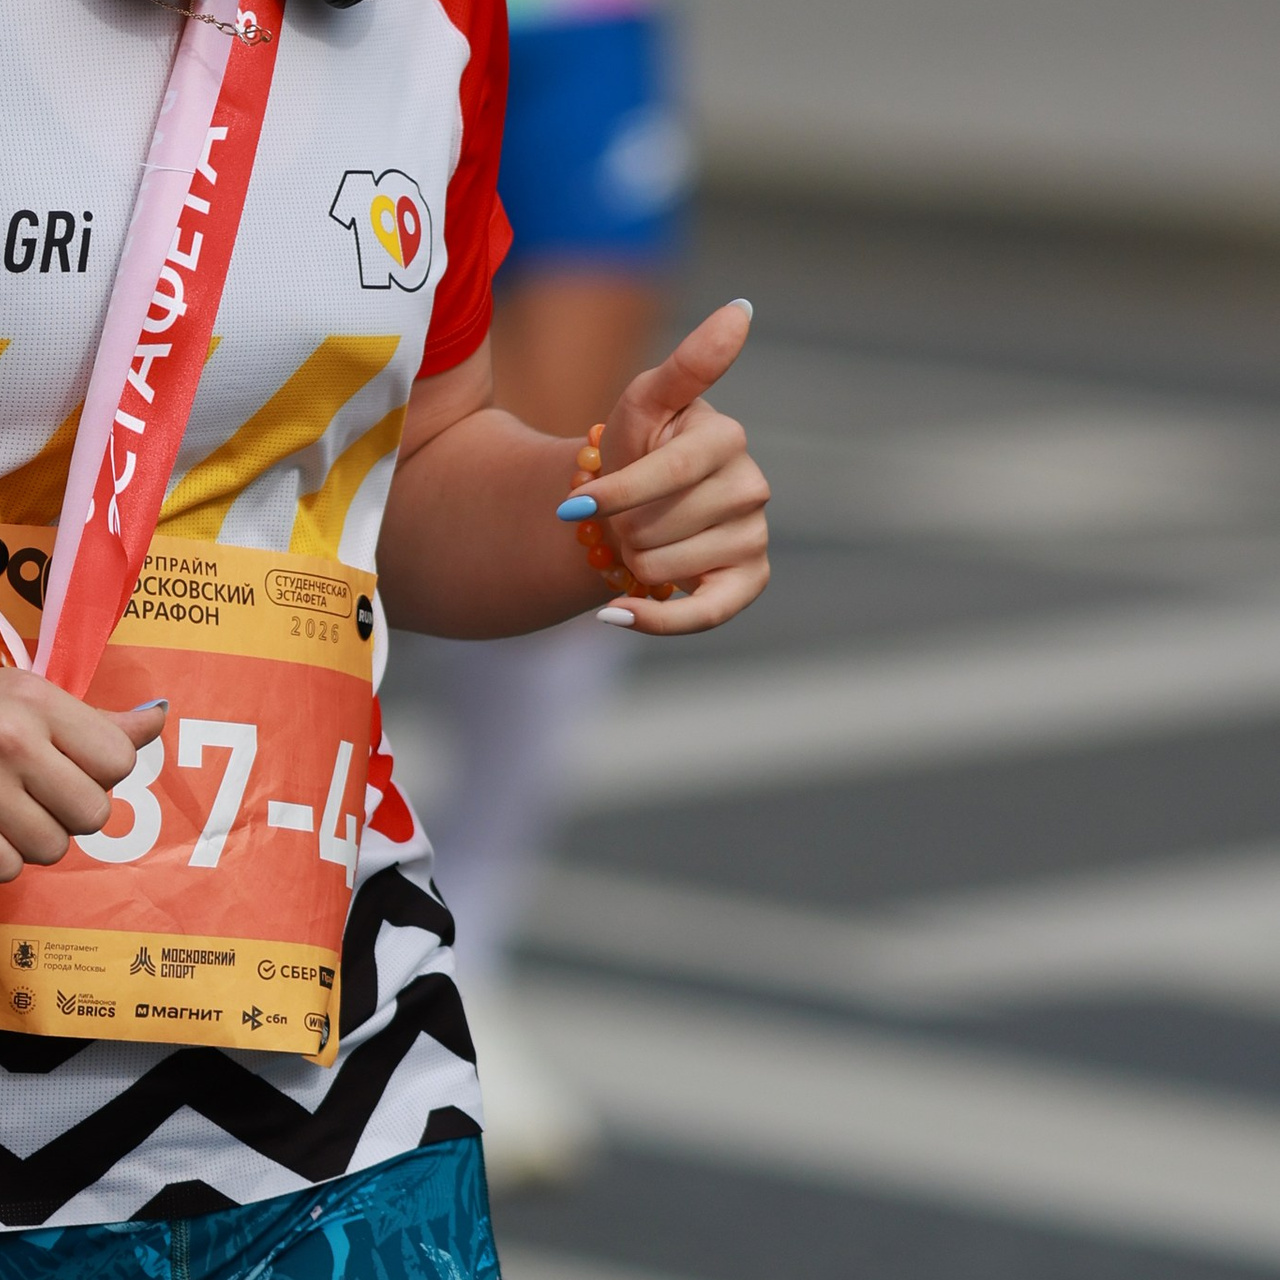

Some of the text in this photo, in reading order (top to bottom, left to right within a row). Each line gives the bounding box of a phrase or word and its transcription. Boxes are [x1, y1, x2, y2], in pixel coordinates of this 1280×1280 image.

[4, 209, 93, 273] GRi
[274, 575, 348, 600] СТУДЕНЧЕСКАЯ
[275, 589, 328, 608] ЭСТАФЕТА
[291, 615, 340, 644] 2026
[44, 941, 99, 953] Департамент
[44, 954, 73, 963] спорта
[161, 948, 236, 966] МОСКОВСКИЙ
[43, 963, 107, 973] города Москвы
[160, 964, 196, 979] СПОРТ
[280, 965, 318, 981] СБЕР
[77, 1006, 116, 1018] BRICS
